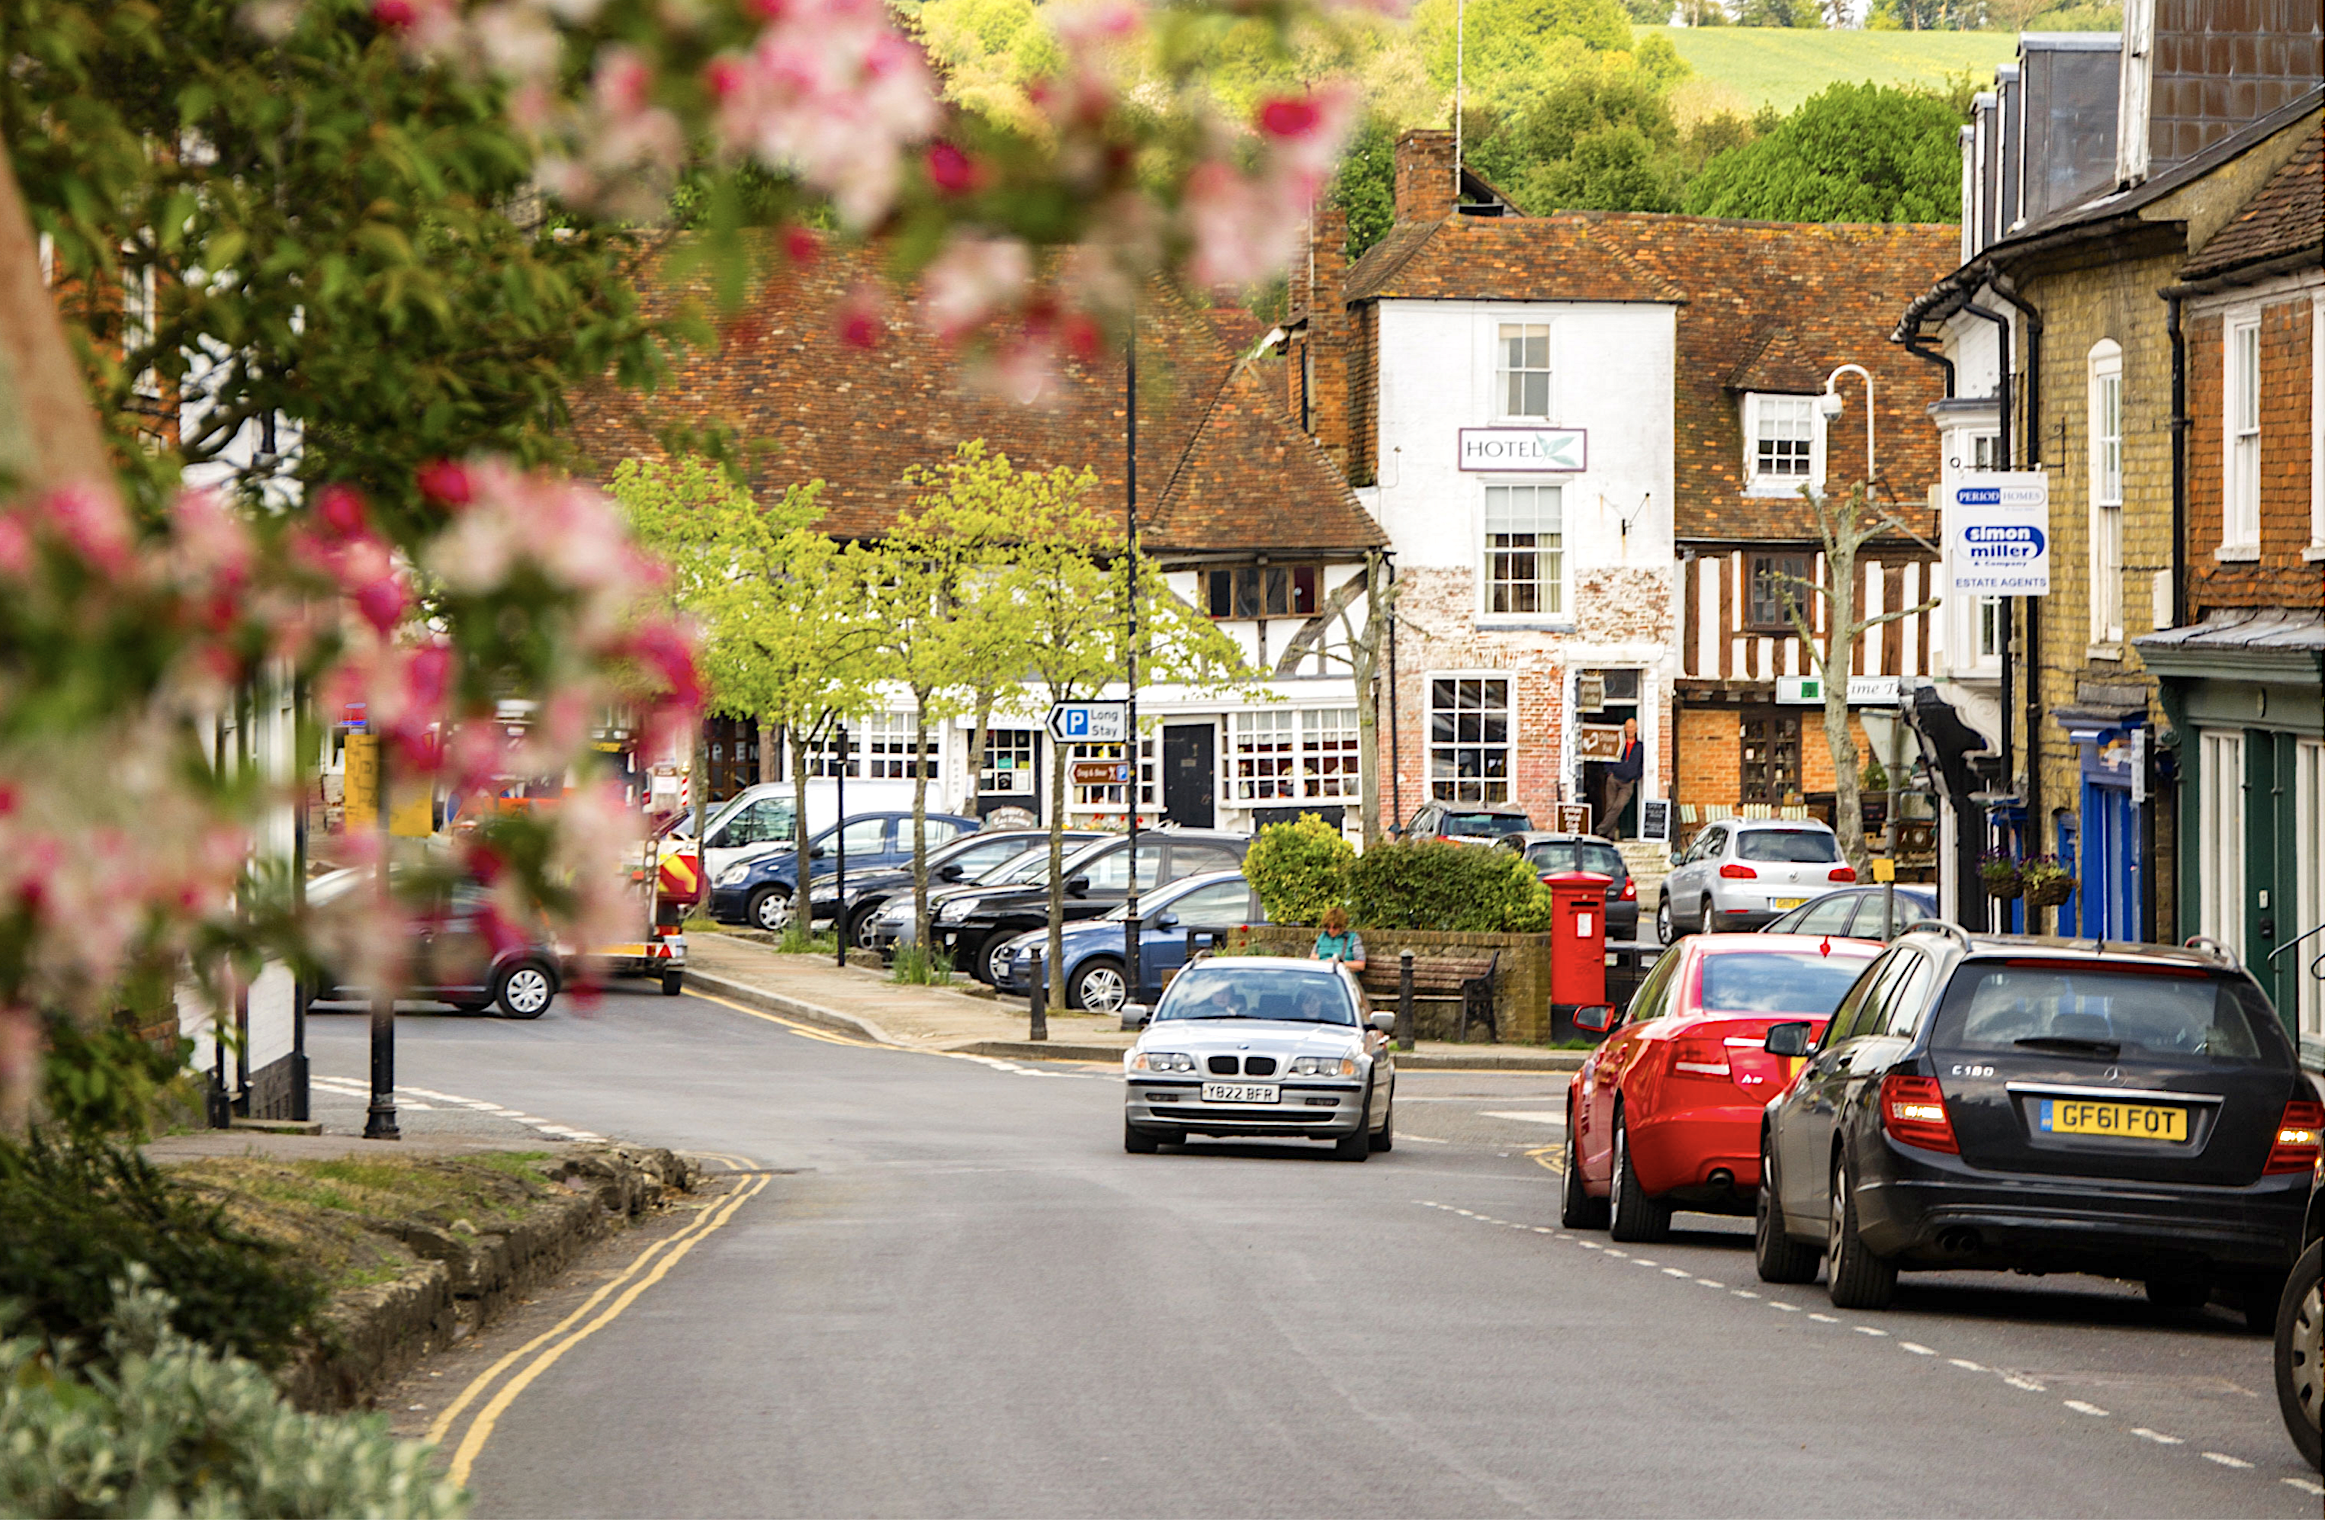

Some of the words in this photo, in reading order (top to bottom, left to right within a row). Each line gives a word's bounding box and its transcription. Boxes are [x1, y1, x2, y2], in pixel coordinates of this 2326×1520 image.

[1467, 441, 1543, 457] HOTEL
[1959, 490, 2000, 502] PERIOD
[2003, 490, 2040, 501] HOMES
[1969, 526, 2031, 541] simon
[1971, 544, 2029, 557] miller
[1956, 578, 1997, 588] ESTATE
[2001, 577, 2047, 588] AGENTS
[1070, 712, 1084, 733] P
[1091, 709, 1119, 722] Long
[1091, 725, 1118, 738] Stay
[1208, 1085, 1243, 1099] Y822
[1246, 1087, 1273, 1101] BFR
[2063, 1105, 2119, 1129] GF61
[2127, 1109, 2176, 1134] FOT
